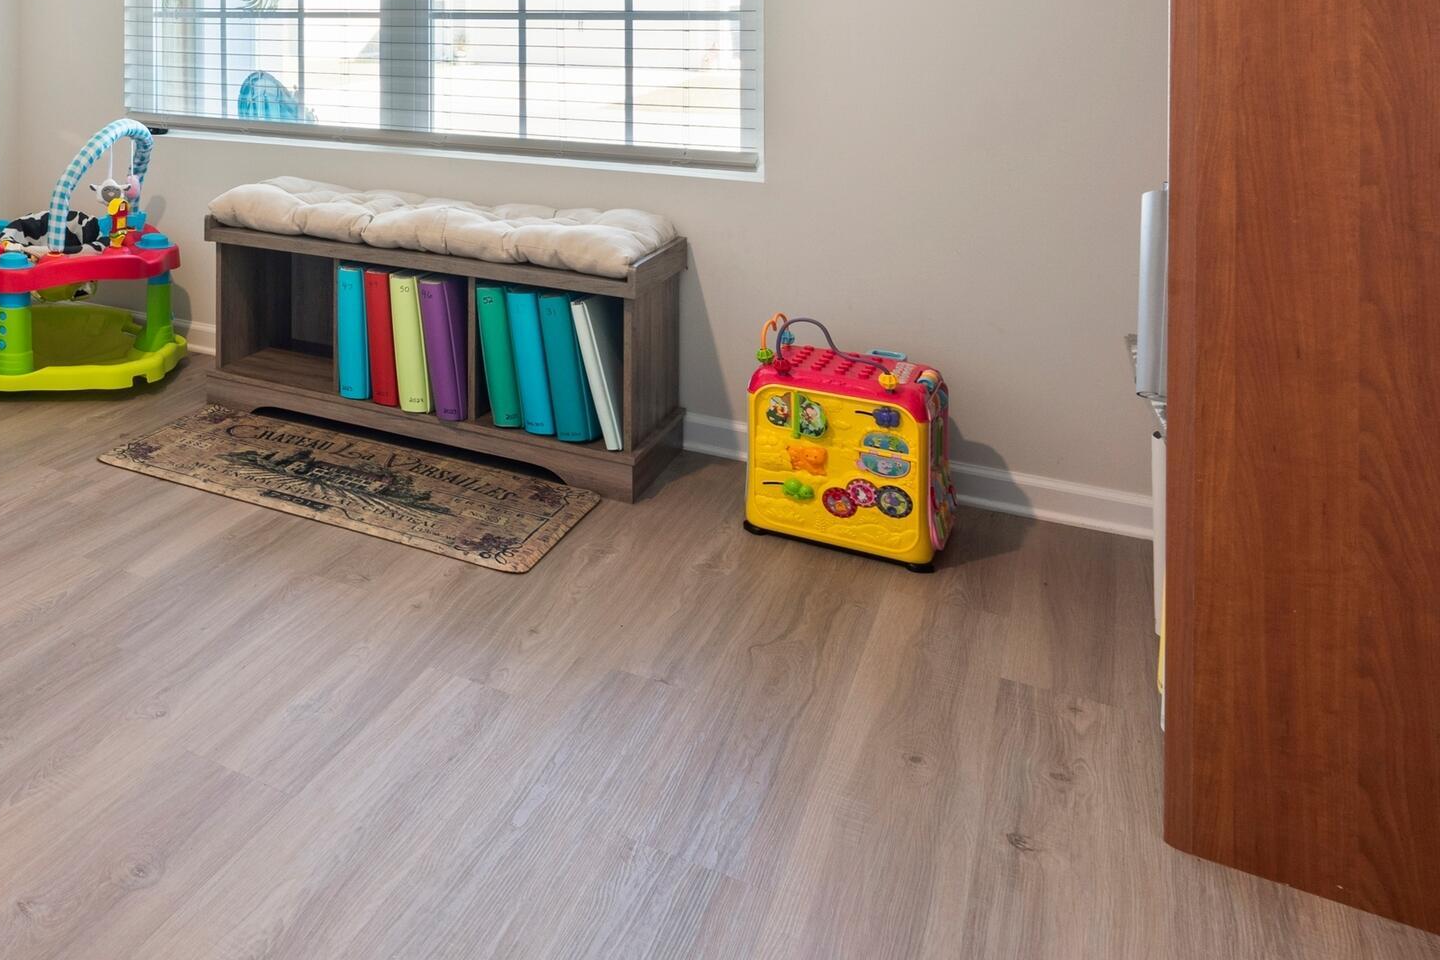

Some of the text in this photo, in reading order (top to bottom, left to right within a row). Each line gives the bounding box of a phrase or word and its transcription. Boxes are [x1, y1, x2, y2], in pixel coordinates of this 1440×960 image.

[399, 285, 410, 293] 50
[482, 296, 493, 305] 52
[225, 424, 336, 452] CHATEAU
[331, 441, 375, 463] La
[383, 451, 518, 501] VERSAILLES
